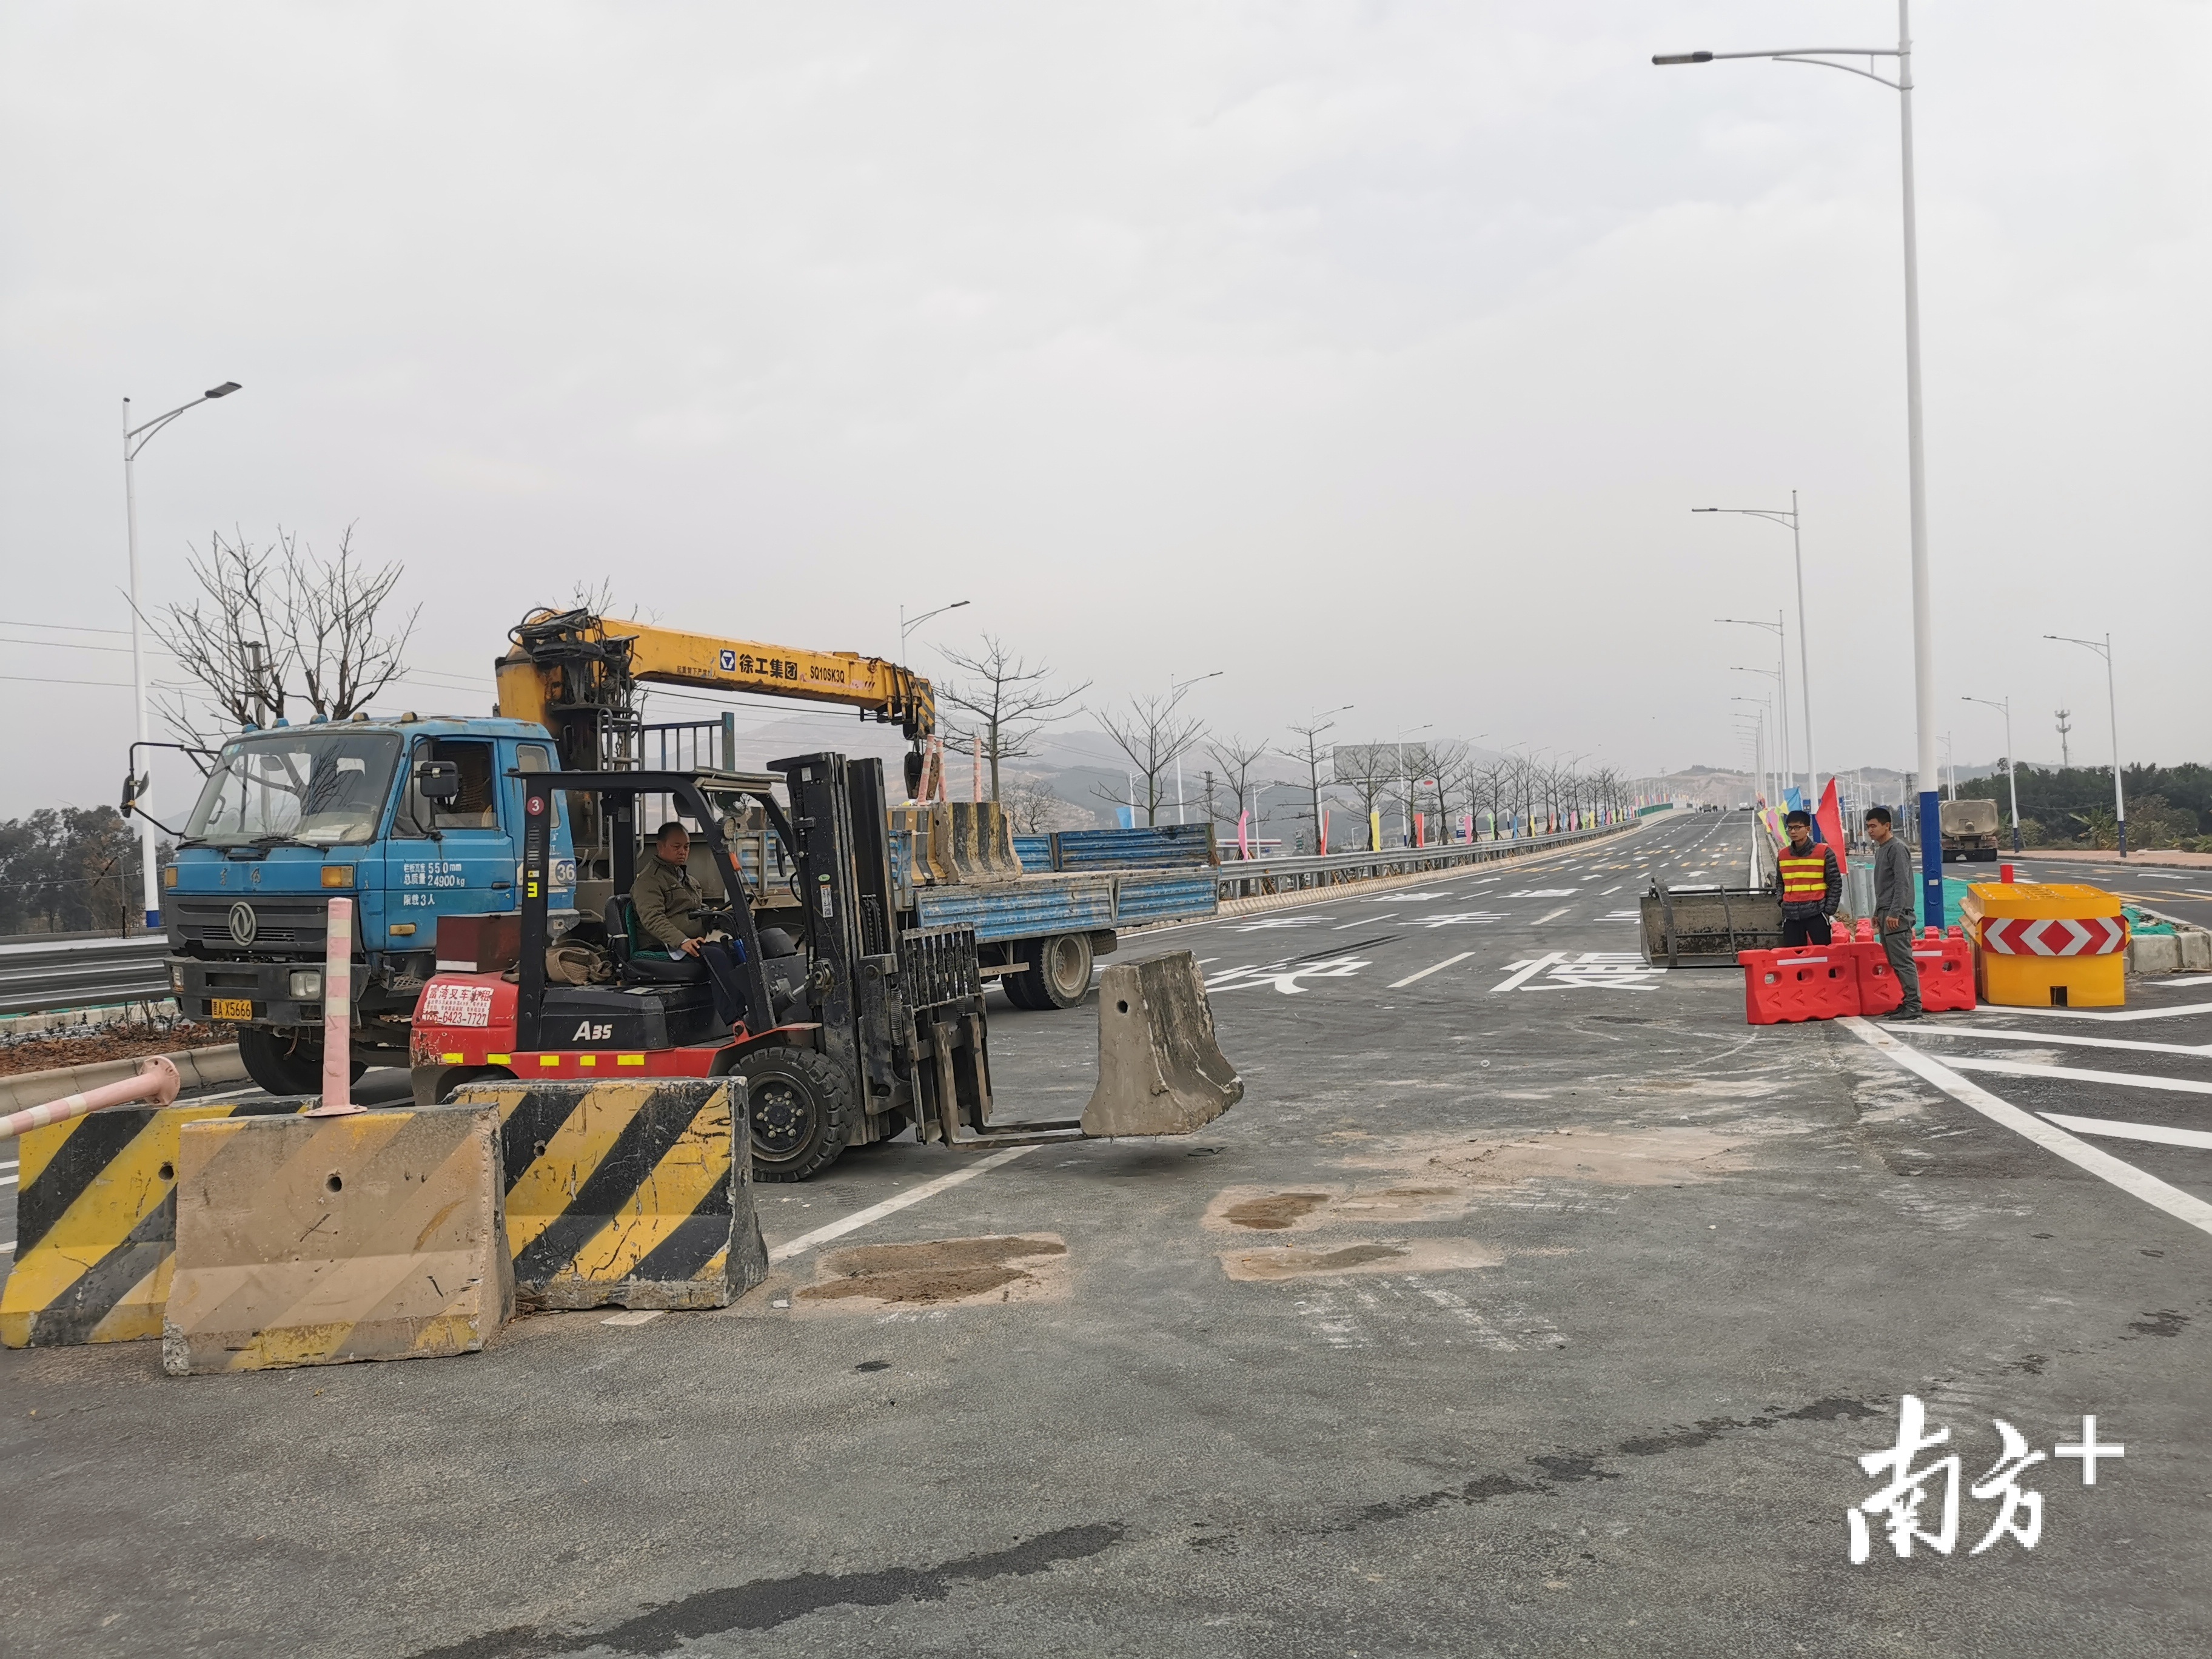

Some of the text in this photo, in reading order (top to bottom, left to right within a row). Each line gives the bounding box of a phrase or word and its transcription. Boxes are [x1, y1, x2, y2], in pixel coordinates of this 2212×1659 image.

[739, 654, 797, 680] 徐工集团
[809, 665, 845, 683] SQ10SK3Q
[532, 799, 540, 812] 3
[557, 863, 575, 881] 36
[1216, 915, 1337, 932] 车
[1396, 911, 1512, 928] 车
[572, 1021, 612, 1041] A35
